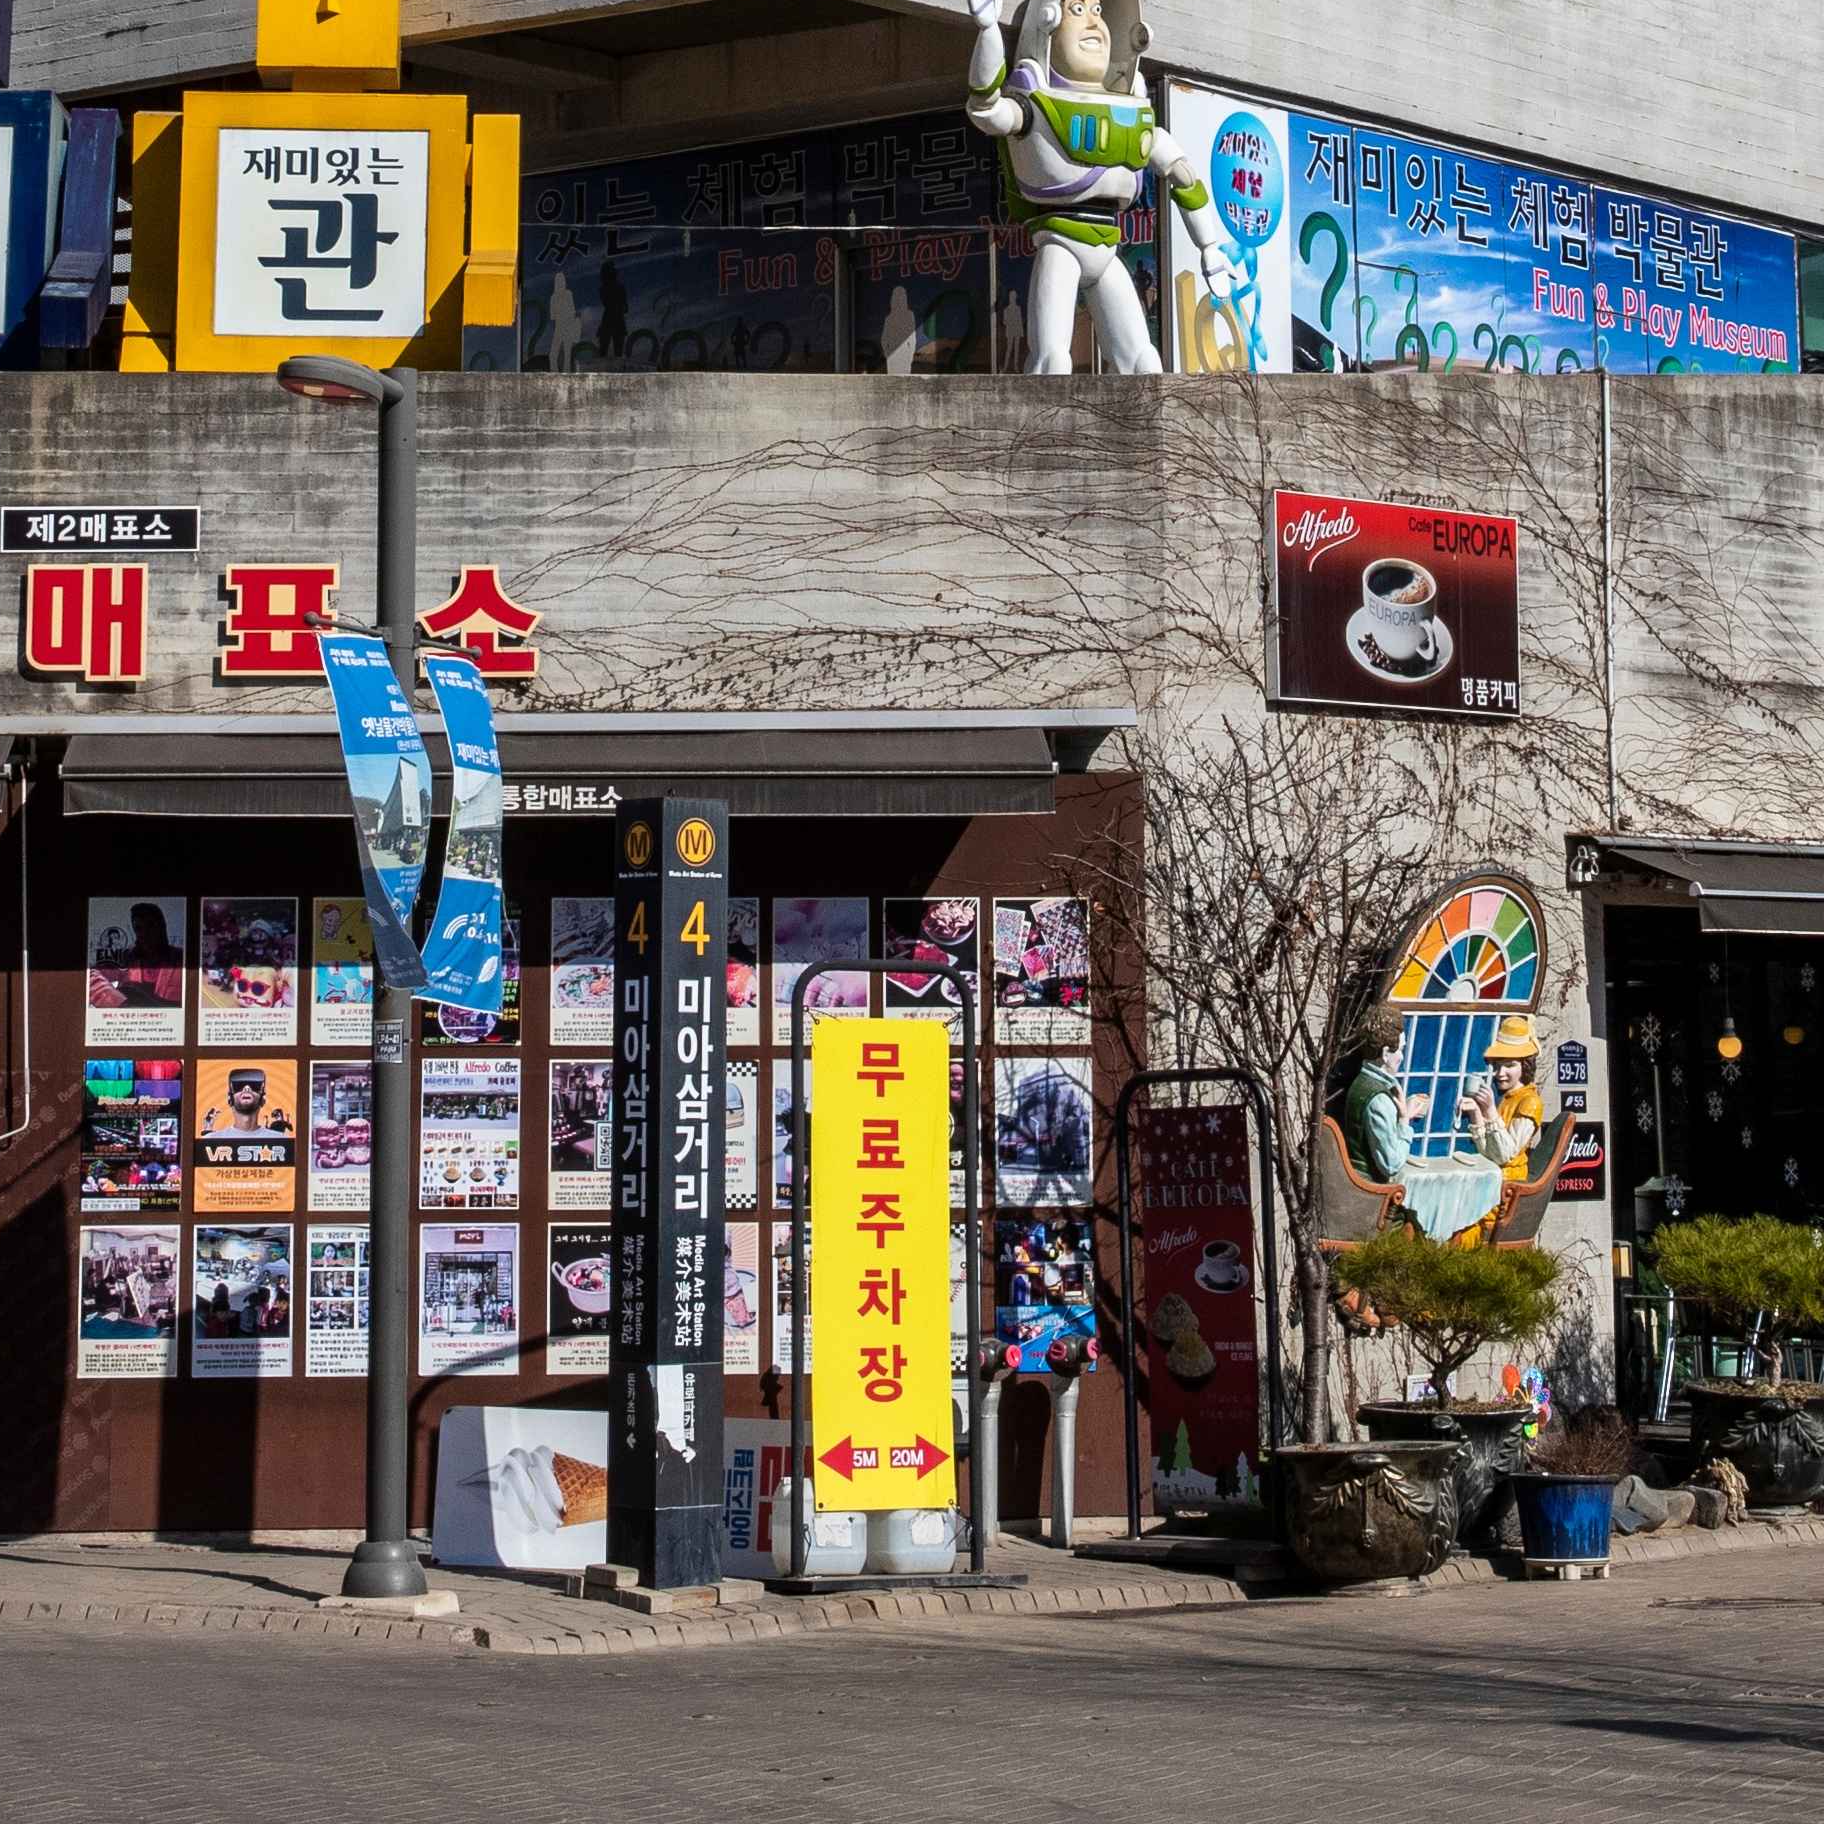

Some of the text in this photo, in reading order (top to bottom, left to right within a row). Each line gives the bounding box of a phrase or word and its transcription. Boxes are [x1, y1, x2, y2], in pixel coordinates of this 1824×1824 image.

[243, 145, 406, 187] 재미있는
[682, 148, 808, 237] 체험
[1305, 130, 1728, 301] 재미있는 체험 박물관
[257, 191, 399, 323] 관
[718, 226, 970, 297] Fun & Play
[1533, 268, 1789, 362] Fun & Play Museum
[26, 510, 174, 545] 제2매표소
[1283, 507, 1356, 551] Alfredo
[1408, 516, 1514, 559] Cafe EUROPA
[1369, 603, 1417, 626] EUROPA
[1461, 677, 1518, 709] 명품커피
[501, 784, 623, 812] 통합매표소
[685, 829, 707, 856] M
[627, 900, 649, 956] 4
[680, 899, 711, 957] 4
[464, 1060, 491, 1073] Alfredo
[494, 1060, 519, 1073] Coffee
[1559, 1062, 1586, 1081] 59-78
[621, 975, 651, 1218] 미아삼거리
[674, 976, 715, 1219] 미아삼거리
[1574, 1096, 1584, 1107] 55
[205, 1144, 233, 1162] VR
[1563, 1133, 1598, 1164] fredo
[855, 1042, 909, 1404] 무료주차장
[1149, 1226, 1198, 1255] Alfredo
[693, 1234, 707, 1347] Media Art Station
[852, 1449, 924, 1467] 5M 20M
